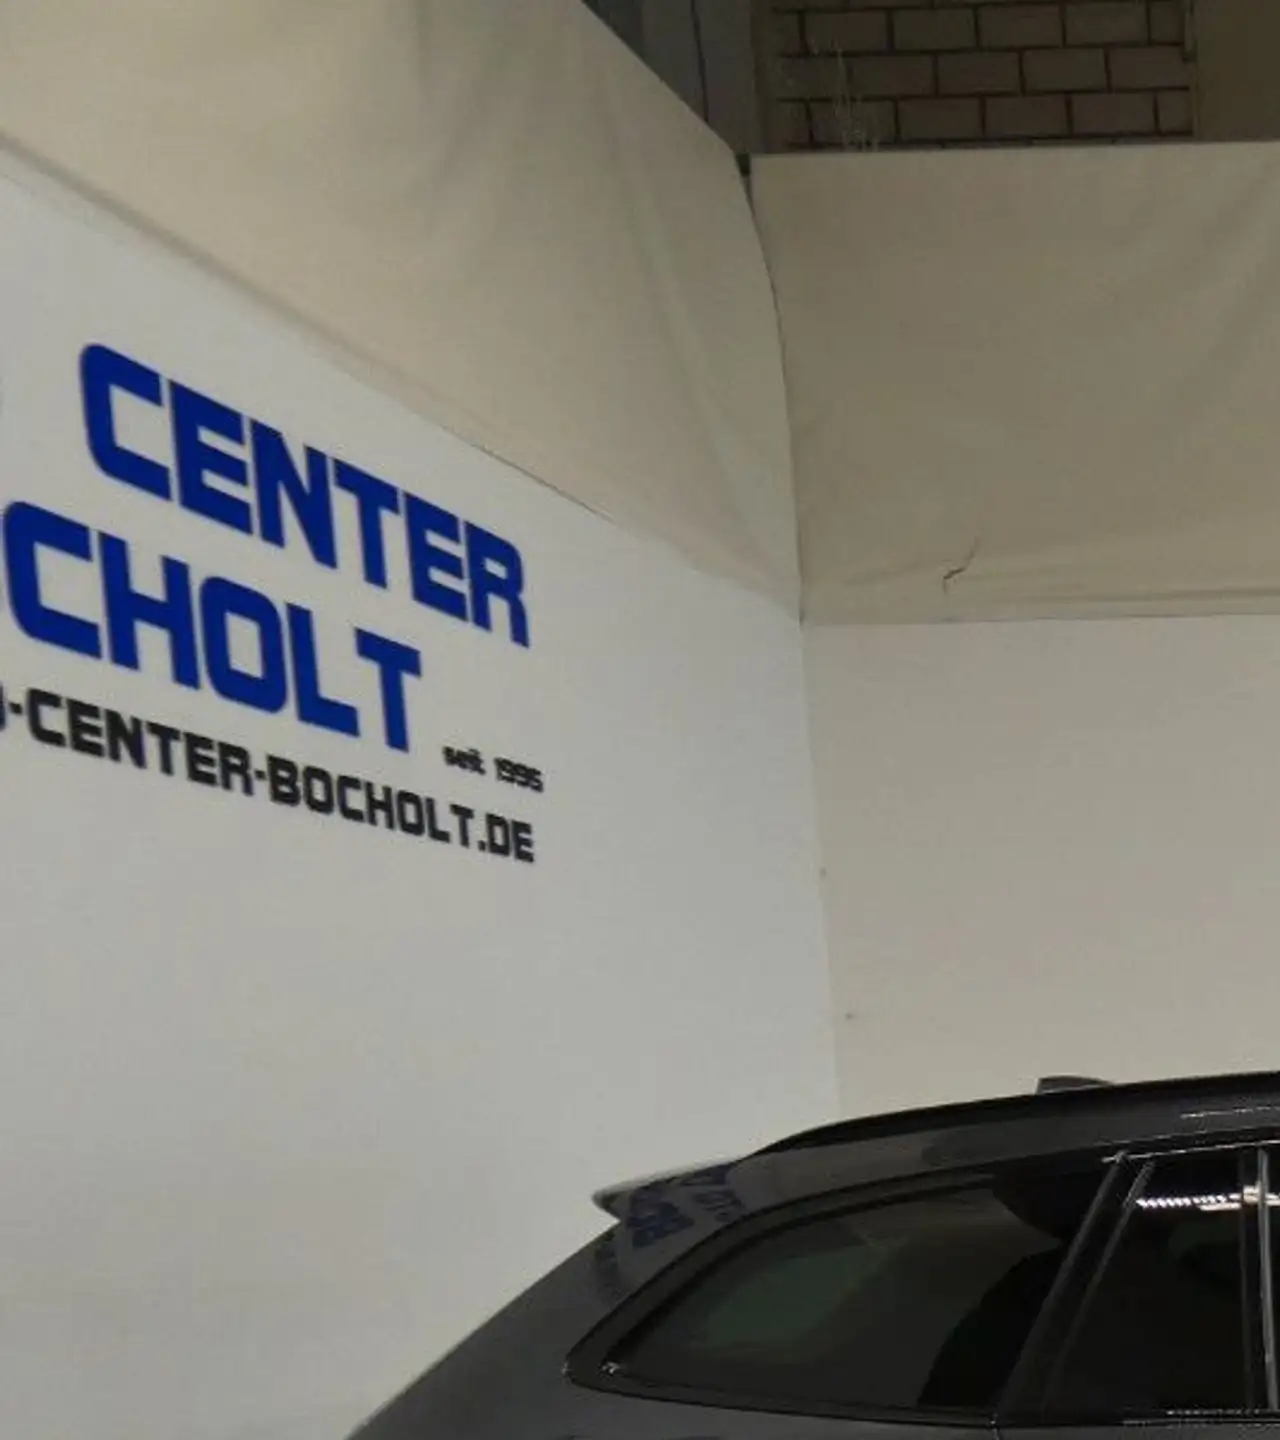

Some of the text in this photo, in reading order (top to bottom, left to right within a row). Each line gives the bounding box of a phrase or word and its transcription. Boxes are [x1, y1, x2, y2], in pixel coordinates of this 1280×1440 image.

[82, 344, 530, 648] CENTER
[442, 745, 544, 793] seit 1995
